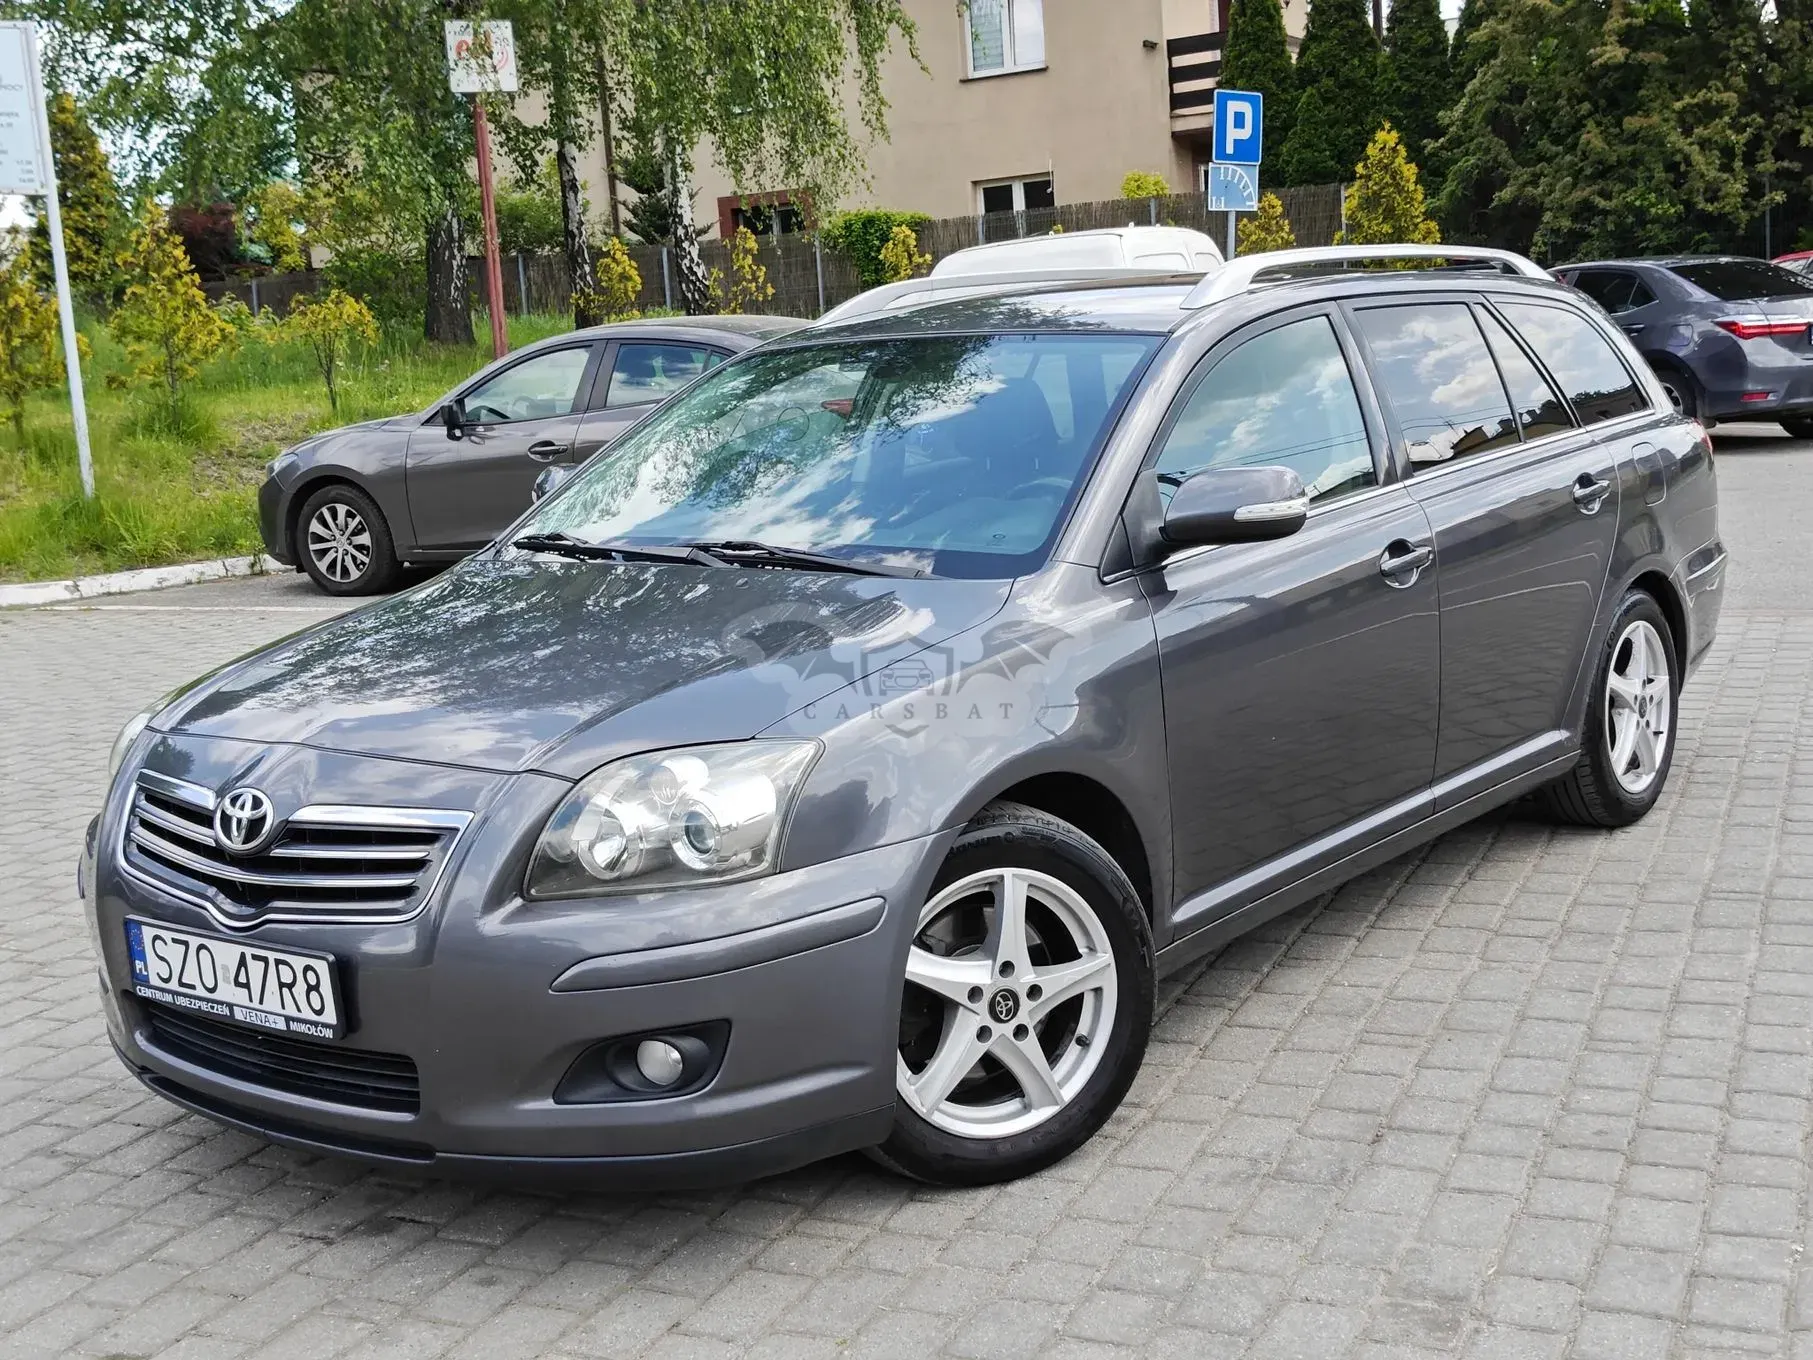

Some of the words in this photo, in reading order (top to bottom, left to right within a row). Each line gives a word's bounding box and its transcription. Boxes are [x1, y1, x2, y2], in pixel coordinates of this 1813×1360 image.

[1225, 100, 1253, 155] P
[135, 960, 148, 976] PL
[151, 933, 219, 994] SZO
[233, 951, 326, 1017] 47R8
[136, 986, 174, 1003] CENTRUM
[174, 994, 230, 1016] UBEZPIECZEŃ
[289, 1020, 334, 1039] MIKOŁÓW
